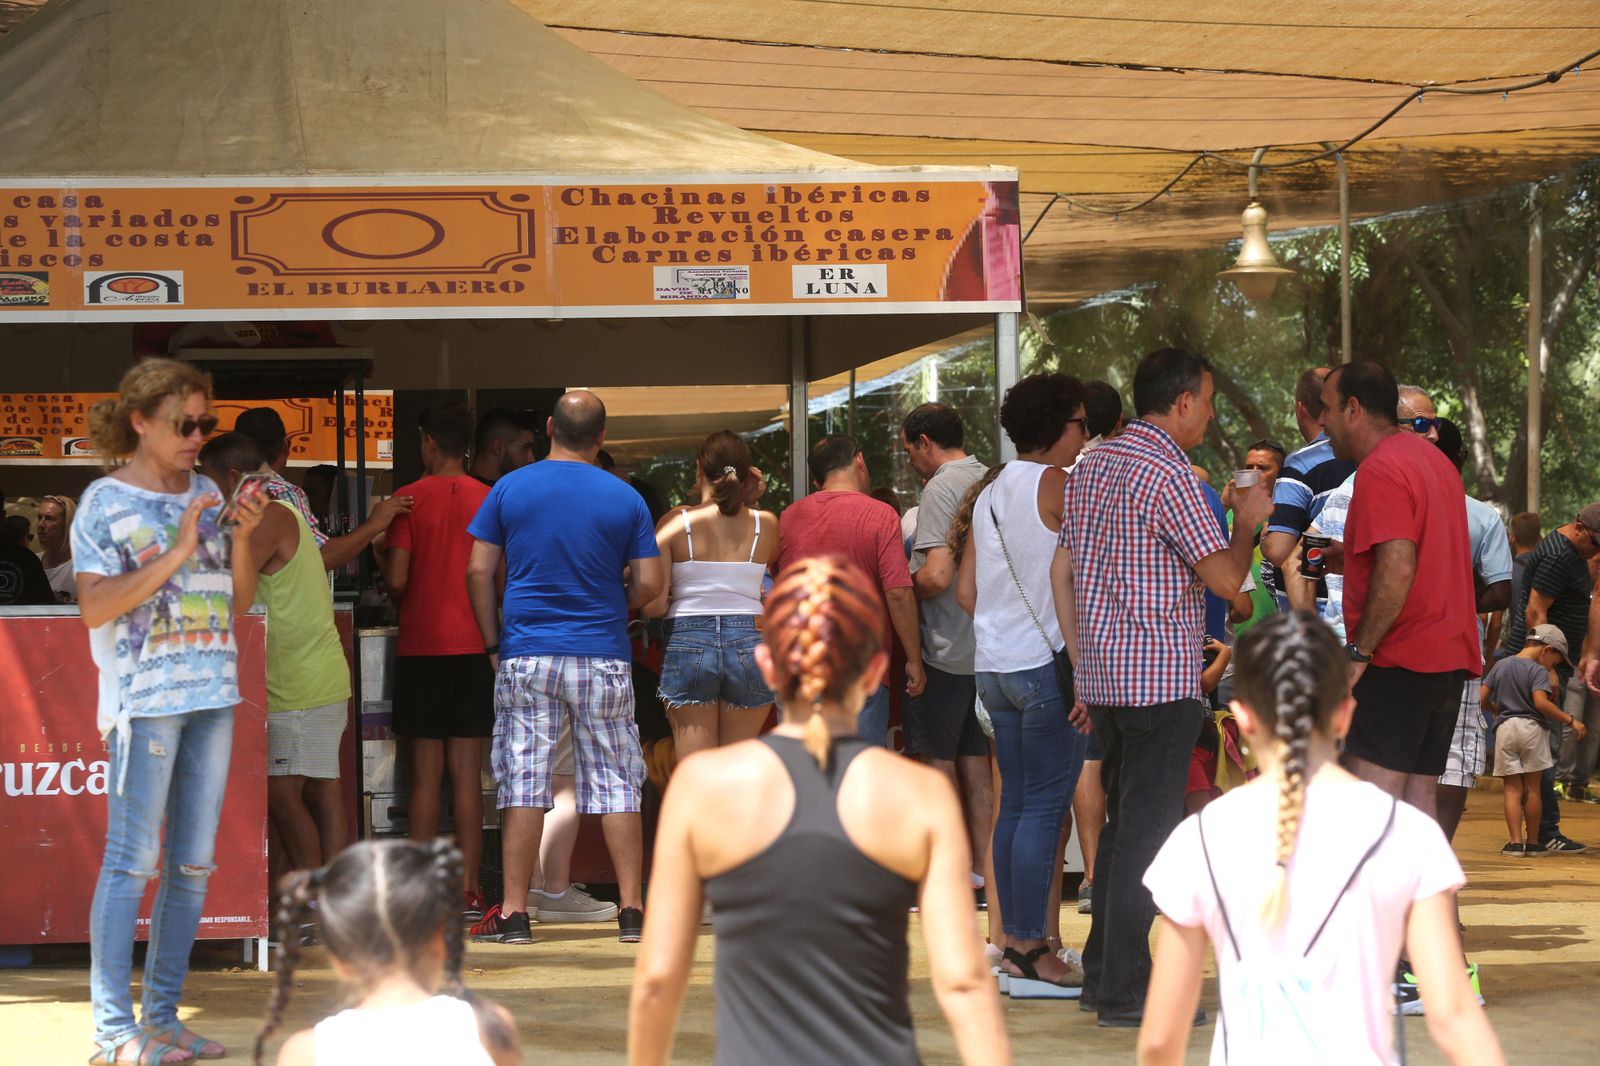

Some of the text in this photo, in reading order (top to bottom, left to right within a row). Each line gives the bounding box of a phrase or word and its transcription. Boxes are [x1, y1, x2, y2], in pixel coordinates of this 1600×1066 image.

[13, 195, 104, 209] casa
[560, 185, 930, 206] Chacinas ibéricas
[39, 208, 220, 228] variados
[652, 205, 854, 225] Revueltos
[46, 229, 86, 248] la
[105, 229, 215, 248] costa
[551, 225, 954, 245] Elaboración casera
[592, 242, 917, 264] Carnes ibéricas
[818, 267, 856, 281] ER
[246, 279, 526, 296] EL BURLAERO
[697, 287, 749, 295] MANZANO
[713, 280, 735, 289] BAR
[805, 281, 878, 295] LUNA
[39, 403, 92, 413] vari
[42, 413, 63, 424] la
[20, 743, 83, 753] DESDE
[0, 758, 111, 797] uzca
